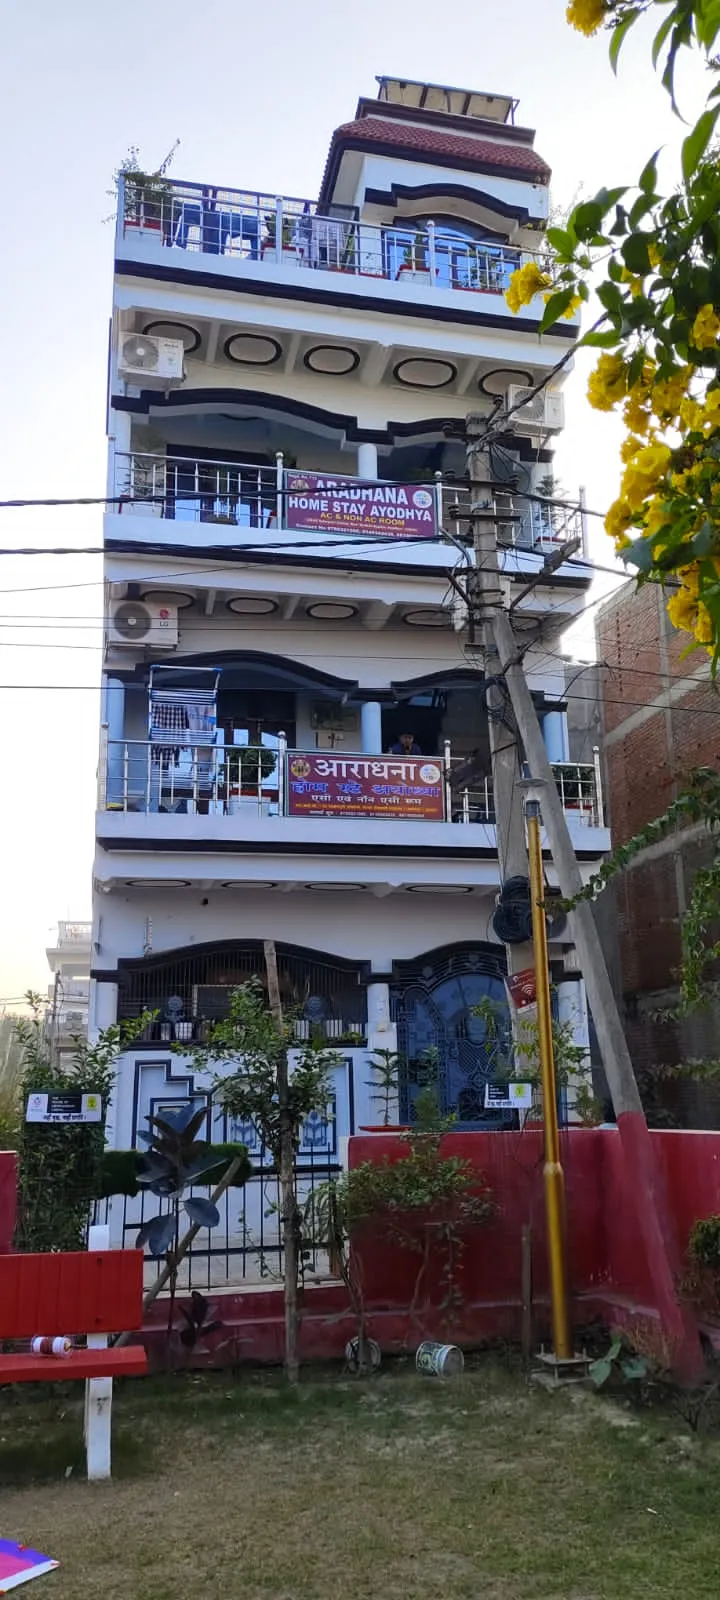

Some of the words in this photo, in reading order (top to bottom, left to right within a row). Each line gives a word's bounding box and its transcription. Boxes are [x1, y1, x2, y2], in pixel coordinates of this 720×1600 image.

[314, 480, 408, 505] ARADHANA
[288, 496, 329, 512] HOME
[333, 501, 366, 515] STAY
[370, 505, 432, 522] AYODHYA
[365, 516, 377, 524] AC
[379, 517, 405, 526] ROOM
[314, 760, 417, 780] आराधना
[291, 776, 329, 794] होम
